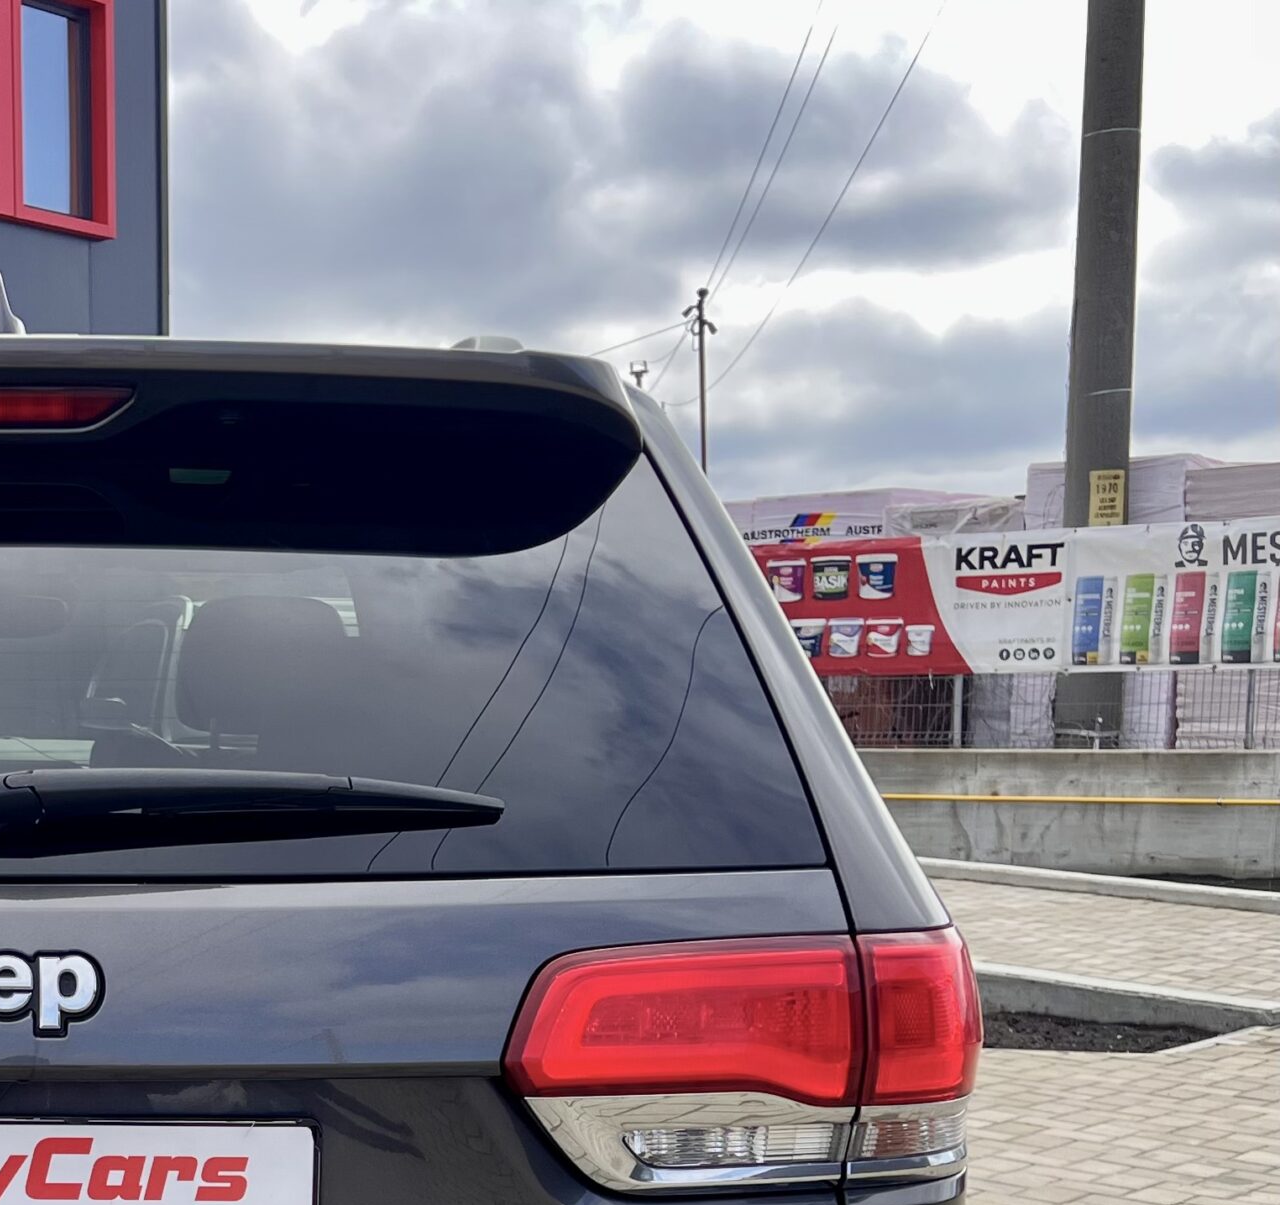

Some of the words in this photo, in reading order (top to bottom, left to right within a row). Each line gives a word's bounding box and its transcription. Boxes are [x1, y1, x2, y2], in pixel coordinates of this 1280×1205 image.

[955, 542, 1065, 571] KRAFT
[981, 577, 1036, 589] PAINTS
[953, 602, 987, 610] DRIVEN
[990, 601, 1001, 610] BY
[1004, 599, 1062, 609] INNOVATION
